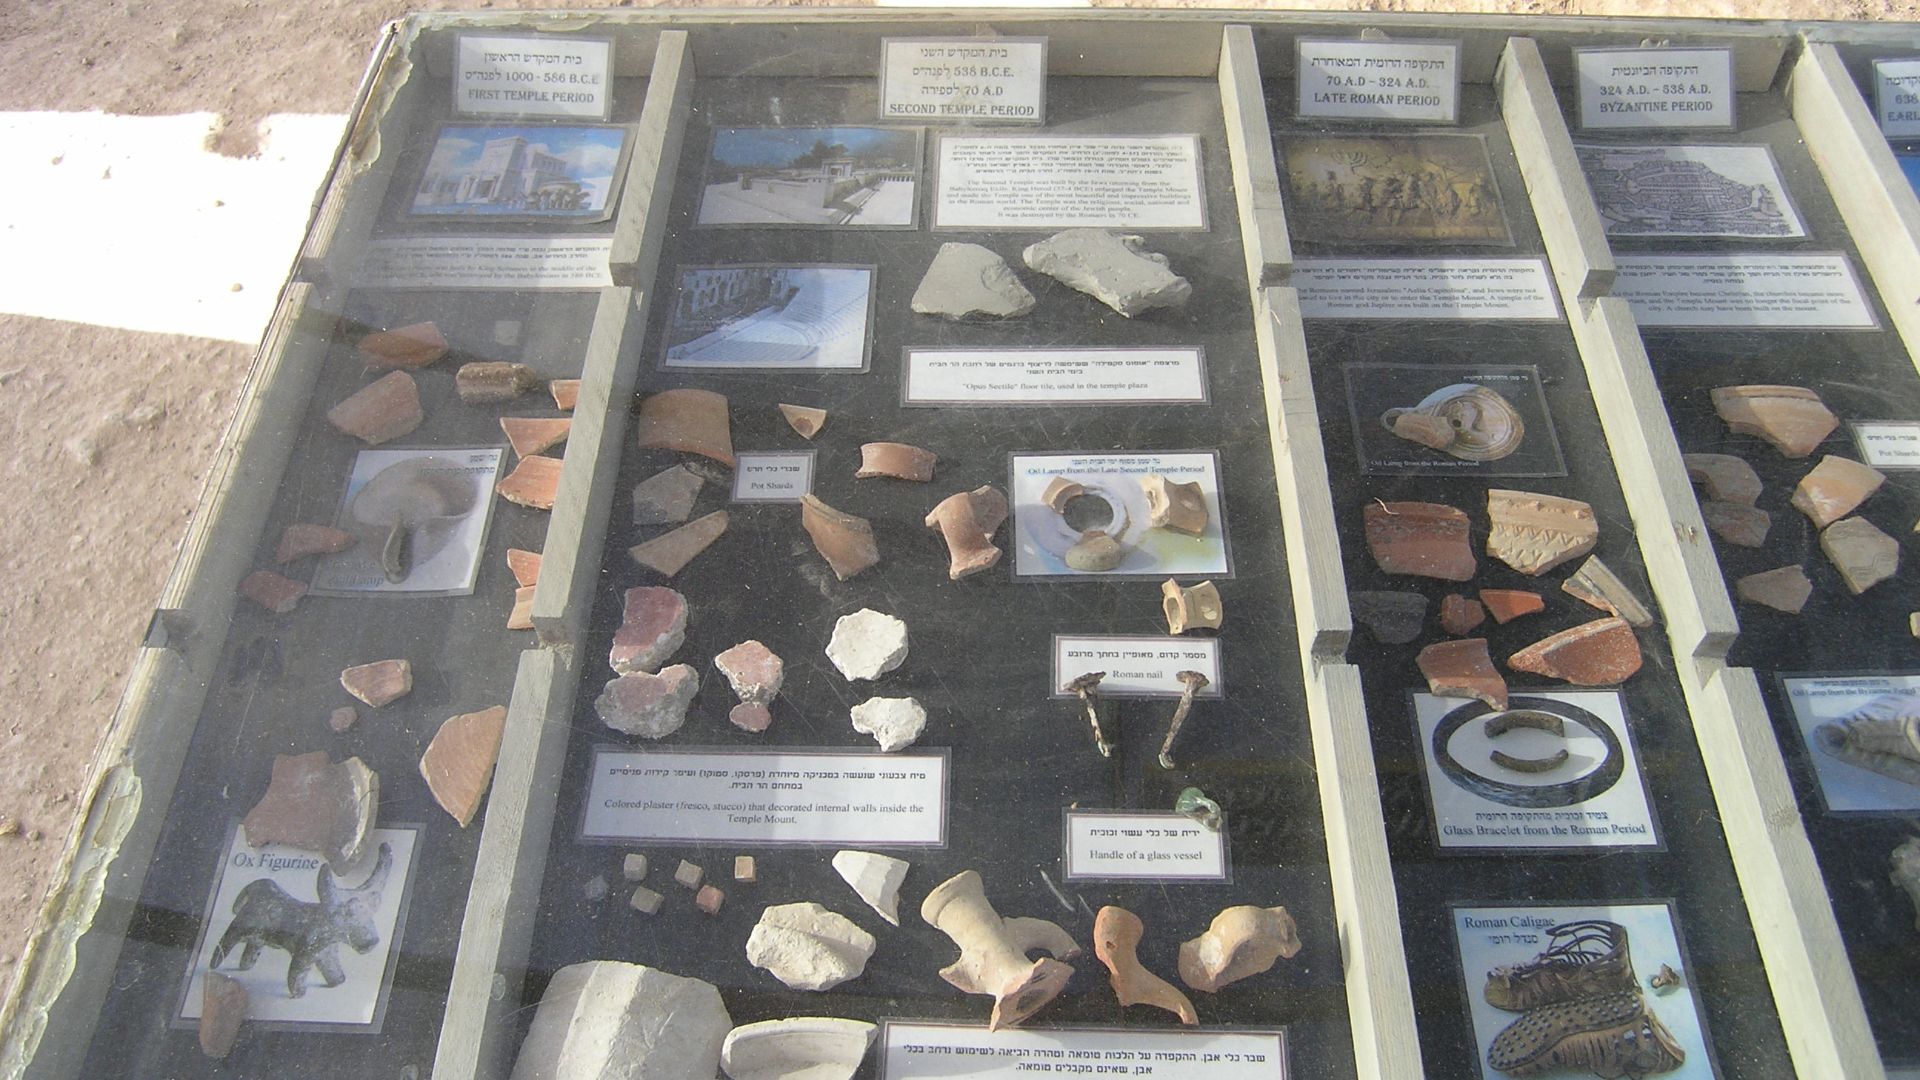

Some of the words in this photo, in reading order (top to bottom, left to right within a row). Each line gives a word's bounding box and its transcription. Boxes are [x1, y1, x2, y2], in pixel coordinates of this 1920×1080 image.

[484, 52, 520, 64] הראשון
[920, 48, 944, 58] השני
[948, 48, 986, 60] המקדש
[988, 48, 1008, 58] בית
[524, 53, 560, 66] המקדש
[563, 53, 583, 65] בית
[1311, 57, 1361, 67] המאוחרת
[1363, 58, 1401, 68] הרומית
[1404, 59, 1445, 71] התקופה
[954, 66, 977, 77] 538
[1659, 65, 1698, 78] התקופה
[505, 72, 534, 82] 1000
[543, 73, 566, 83] 586
[1326, 76, 1341, 86] 70
[1379, 77, 1401, 87] 324
[964, 85, 979, 96] 70
[1600, 85, 1623, 96] 324
[468, 89, 500, 100] FIRST
[504, 90, 549, 102] TEMPLE
[552, 92, 594, 103] PERIOD
[1314, 93, 1347, 103] LATE
[1350, 94, 1394, 105] ROMAN
[1397, 95, 1440, 106] PERIOD
[889, 104, 936, 114] SECOND
[940, 104, 987, 115] TEMPLE
[990, 105, 1034, 116] PERIOD
[1600, 101, 1668, 113] BYZANTINE
[1671, 101, 1713, 111] PERIOD
[1100, 382, 1126, 390] temple
[1042, 467, 1065, 475] Lamp
[1151, 466, 1178, 474] Temple
[1067, 650, 1093, 658] מרובע
[1098, 651, 1119, 659] בחתך
[1183, 651, 1207, 659] מסמר
[1113, 670, 1144, 679] Roman
[1146, 671, 1163, 679] nail
[842, 771, 875, 779] שנעשה
[604, 800, 641, 809] Colored
[643, 801, 673, 810] plaster
[676, 801, 711, 812] (fresco,
[712, 802, 746, 812] stucco)
[748, 803, 766, 811] that
[768, 803, 813, 813] decorated
[815, 803, 850, 813] internal
[852, 804, 877, 813] walls
[879, 804, 907, 813] inside
[909, 804, 924, 813] the
[727, 814, 762, 825] Temple
[764, 815, 798, 824] Mount.
[1475, 812, 1508, 821] הרומית
[1586, 811, 1608, 820] צמיד
[1121, 829, 1143, 837] עשוי
[1146, 828, 1160, 837] כלי
[1163, 828, 1178, 837] של
[1443, 825, 1473, 836] Glass
[1477, 824, 1521, 835] Bracelet
[1523, 824, 1549, 835] from
[1551, 824, 1568, 835] the
[1570, 824, 1609, 835] Roman
[1611, 823, 1646, 834] Period
[1089, 850, 1124, 860] Handle
[1126, 850, 1137, 860] of
[1139, 852, 1145, 860] a
[1147, 851, 1171, 862] glass
[1173, 851, 1202, 860] vessel
[234, 853, 254, 867] Ox
[257, 854, 320, 872] Figurine
[1464, 916, 1508, 928] Roman
[1488, 935, 1511, 945] רומי
[1514, 932, 1539, 944] סנדל
[903, 1044, 924, 1054] בכלי
[928, 1046, 952, 1055] נרחב
[955, 1046, 994, 1056] לשימוש
[998, 1048, 1030, 1057] הביאה
[1105, 1051, 1135, 1060] הלכות
[1138, 1051, 1151, 1060] על
[1154, 1053, 1196, 1062] ההקפדה
[1224, 1053, 1240, 1062] כלי
[1244, 1054, 1266, 1063] שבר
[1055, 1062, 1092, 1074] מקבלים
[1096, 1065, 1128, 1074] שאינם
